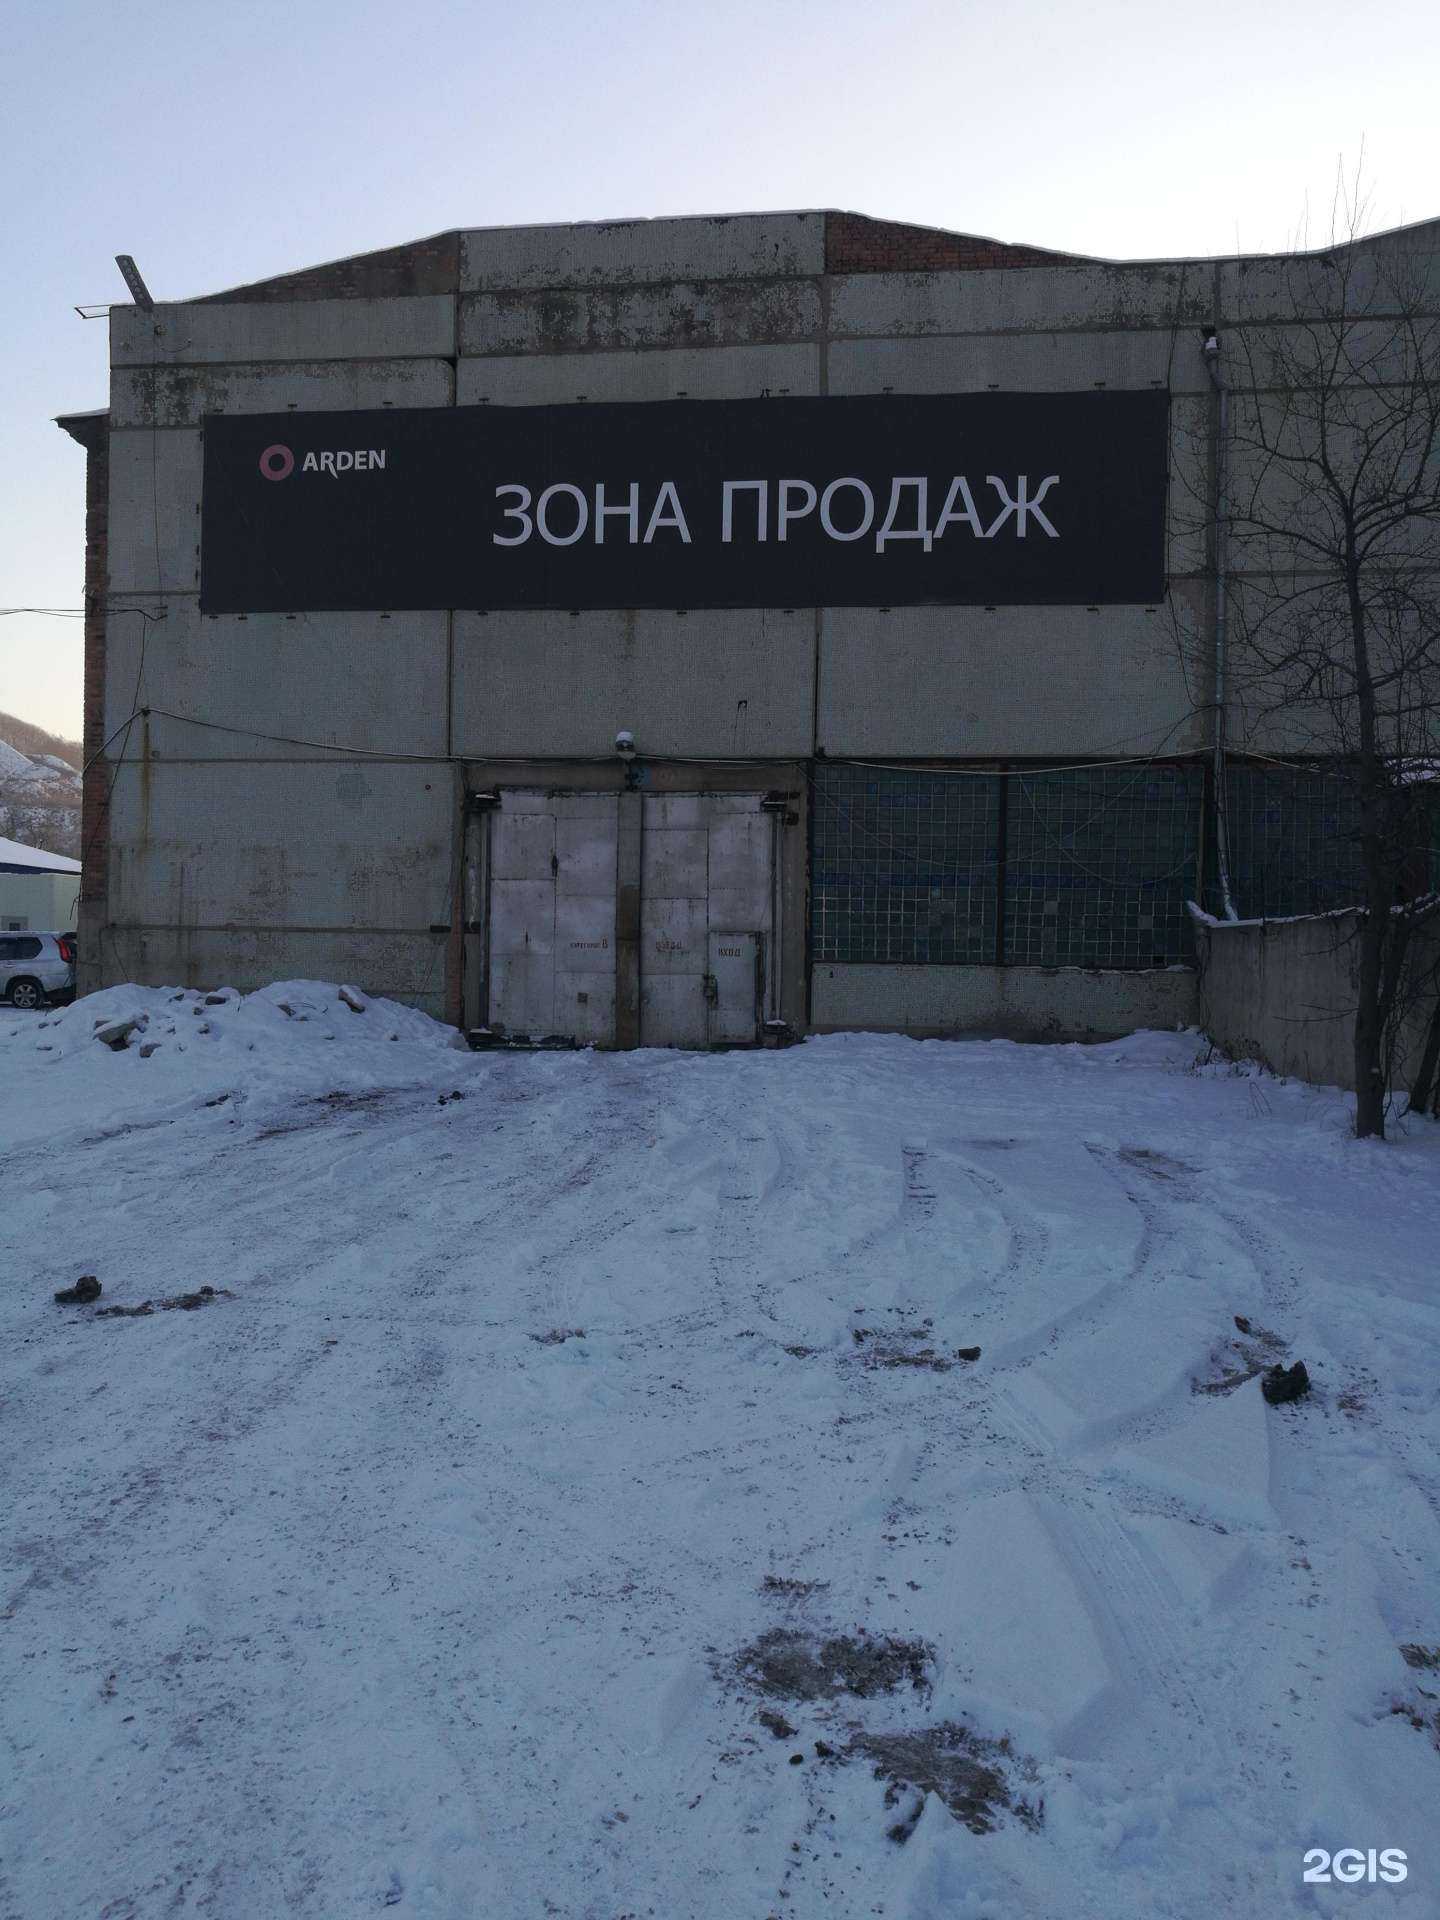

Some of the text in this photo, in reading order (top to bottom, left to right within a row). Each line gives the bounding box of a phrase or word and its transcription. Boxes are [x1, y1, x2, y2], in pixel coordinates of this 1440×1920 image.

[302, 449, 386, 479] ARDEN
[492, 475, 1060, 553] ЗОНА ПРОДАЖ
